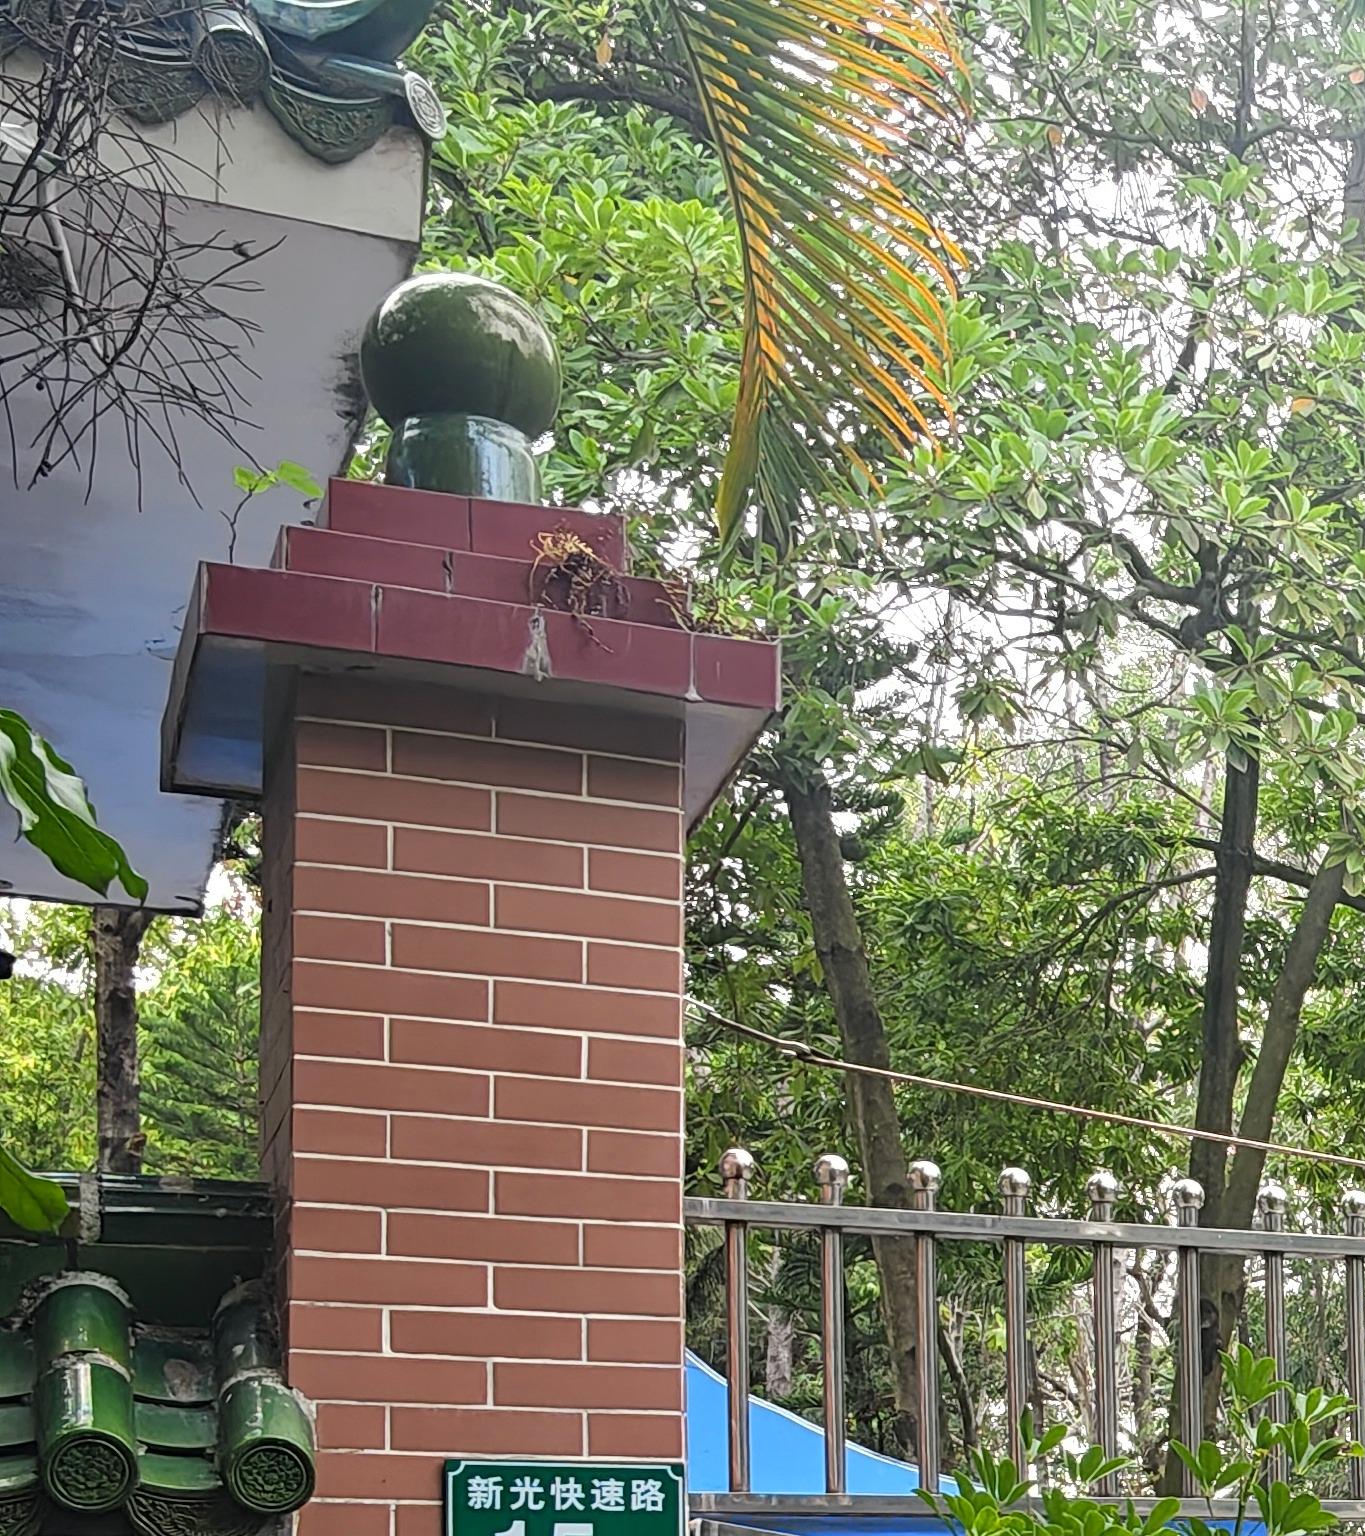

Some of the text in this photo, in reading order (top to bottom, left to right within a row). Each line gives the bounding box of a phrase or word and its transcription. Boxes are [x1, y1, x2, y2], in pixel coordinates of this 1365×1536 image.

[467, 1475, 666, 1512] 新光快速路
